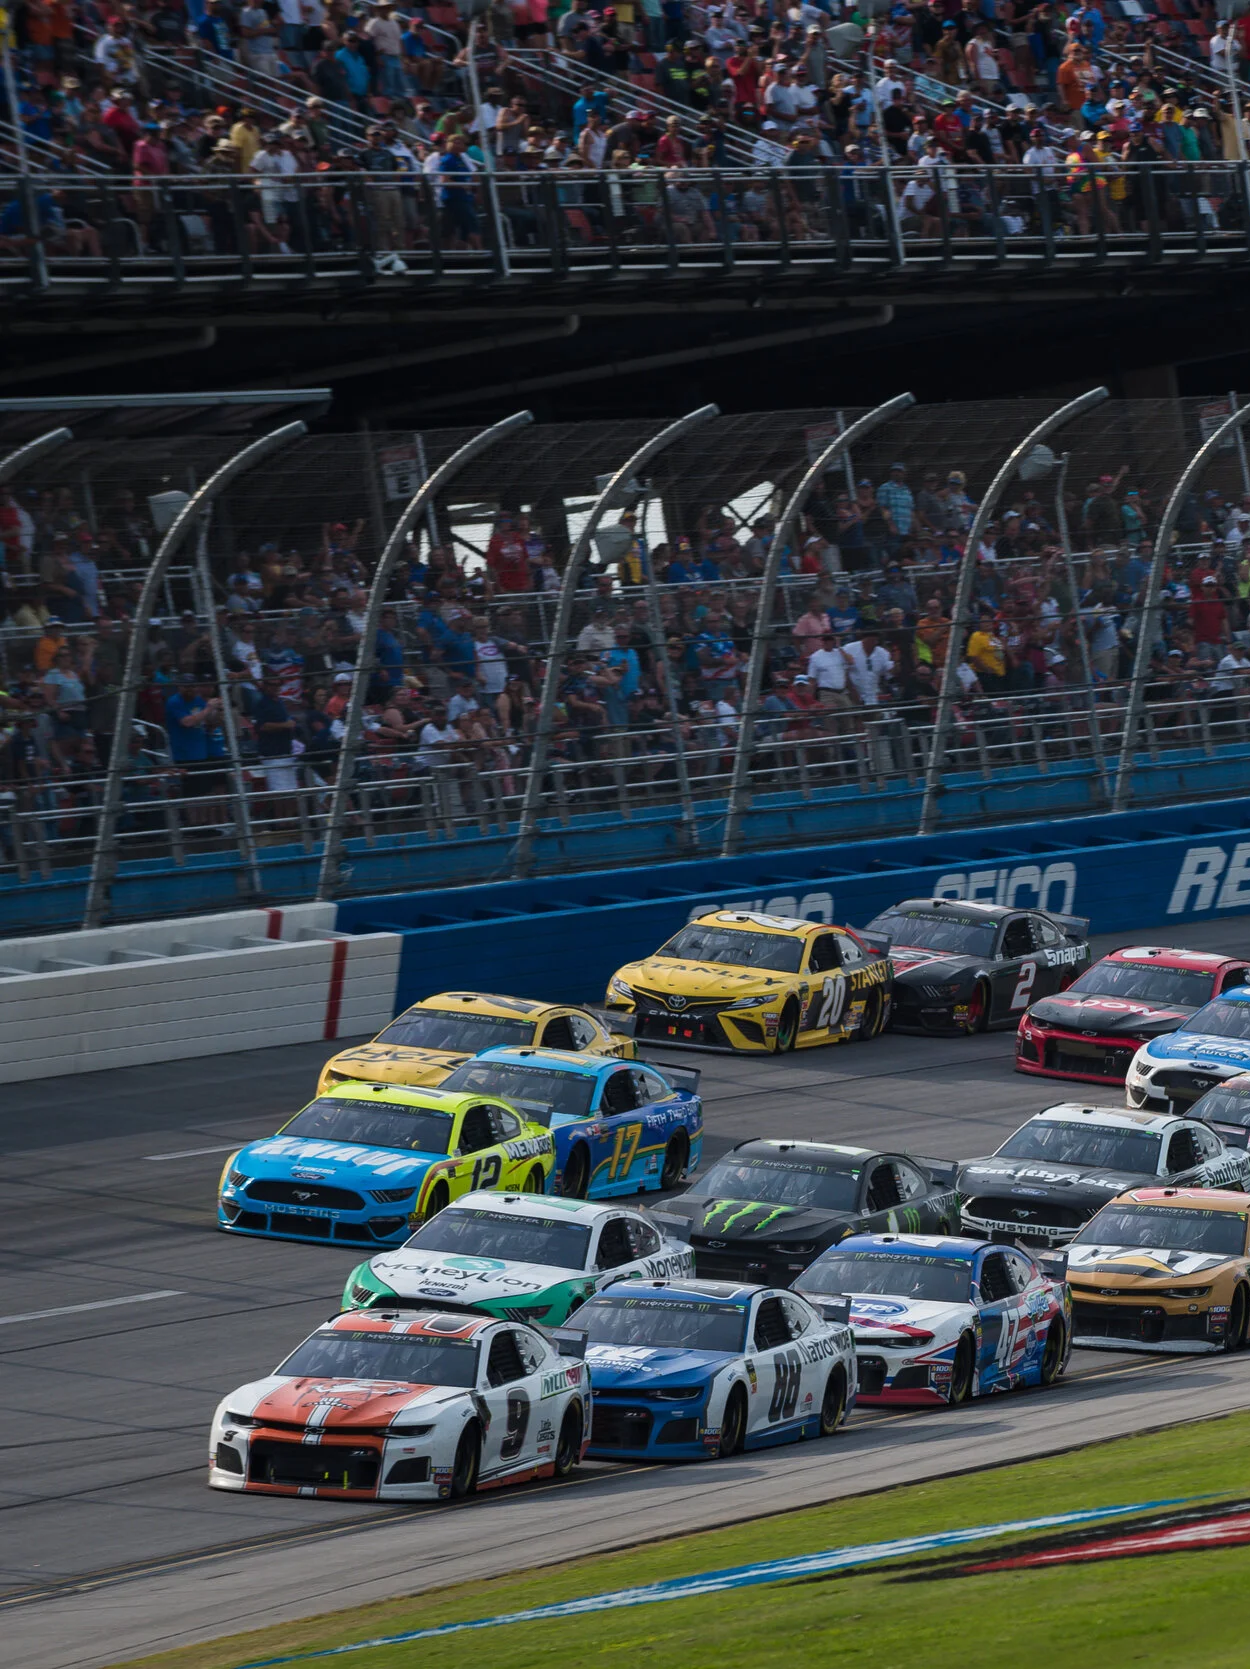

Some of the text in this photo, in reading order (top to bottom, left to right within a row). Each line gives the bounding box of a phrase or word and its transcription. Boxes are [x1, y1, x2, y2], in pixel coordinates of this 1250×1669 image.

[628, 961, 785, 986] STANLEY
[850, 960, 887, 991] STANLEY
[1009, 961, 1037, 1011] 2
[816, 975, 846, 1028] 20
[1025, 1030, 1033, 1041] 3
[343, 1048, 470, 1067] Her
[645, 1112, 667, 1127] FIFTH
[249, 1136, 433, 1176] KNAUF
[502, 1134, 552, 1162] MENARDS
[607, 1123, 643, 1180] 17
[470, 1152, 502, 1192] 12
[764, 1160, 812, 1171] MONSTER
[966, 1166, 1129, 1191] Smithfield
[1205, 1155, 1250, 1188] Smithfield
[263, 1202, 341, 1219] MUSTANG
[489, 1212, 542, 1224] MONSTER
[1149, 1206, 1198, 1216] MONSTER
[985, 1220, 1060, 1236] MUSTANG
[869, 1253, 921, 1262] MONSTER
[1067, 1244, 1229, 1274] CAT
[373, 1261, 543, 1291] MoneyLion
[418, 1277, 469, 1291] PENNZOIL
[640, 1300, 694, 1311] MONSTER
[366, 1332, 425, 1343] MONSTER
[796, 1330, 850, 1365] Nationwide
[995, 1308, 1020, 1369] 47
[768, 1348, 802, 1423] 88
[501, 1387, 531, 1461] 9
